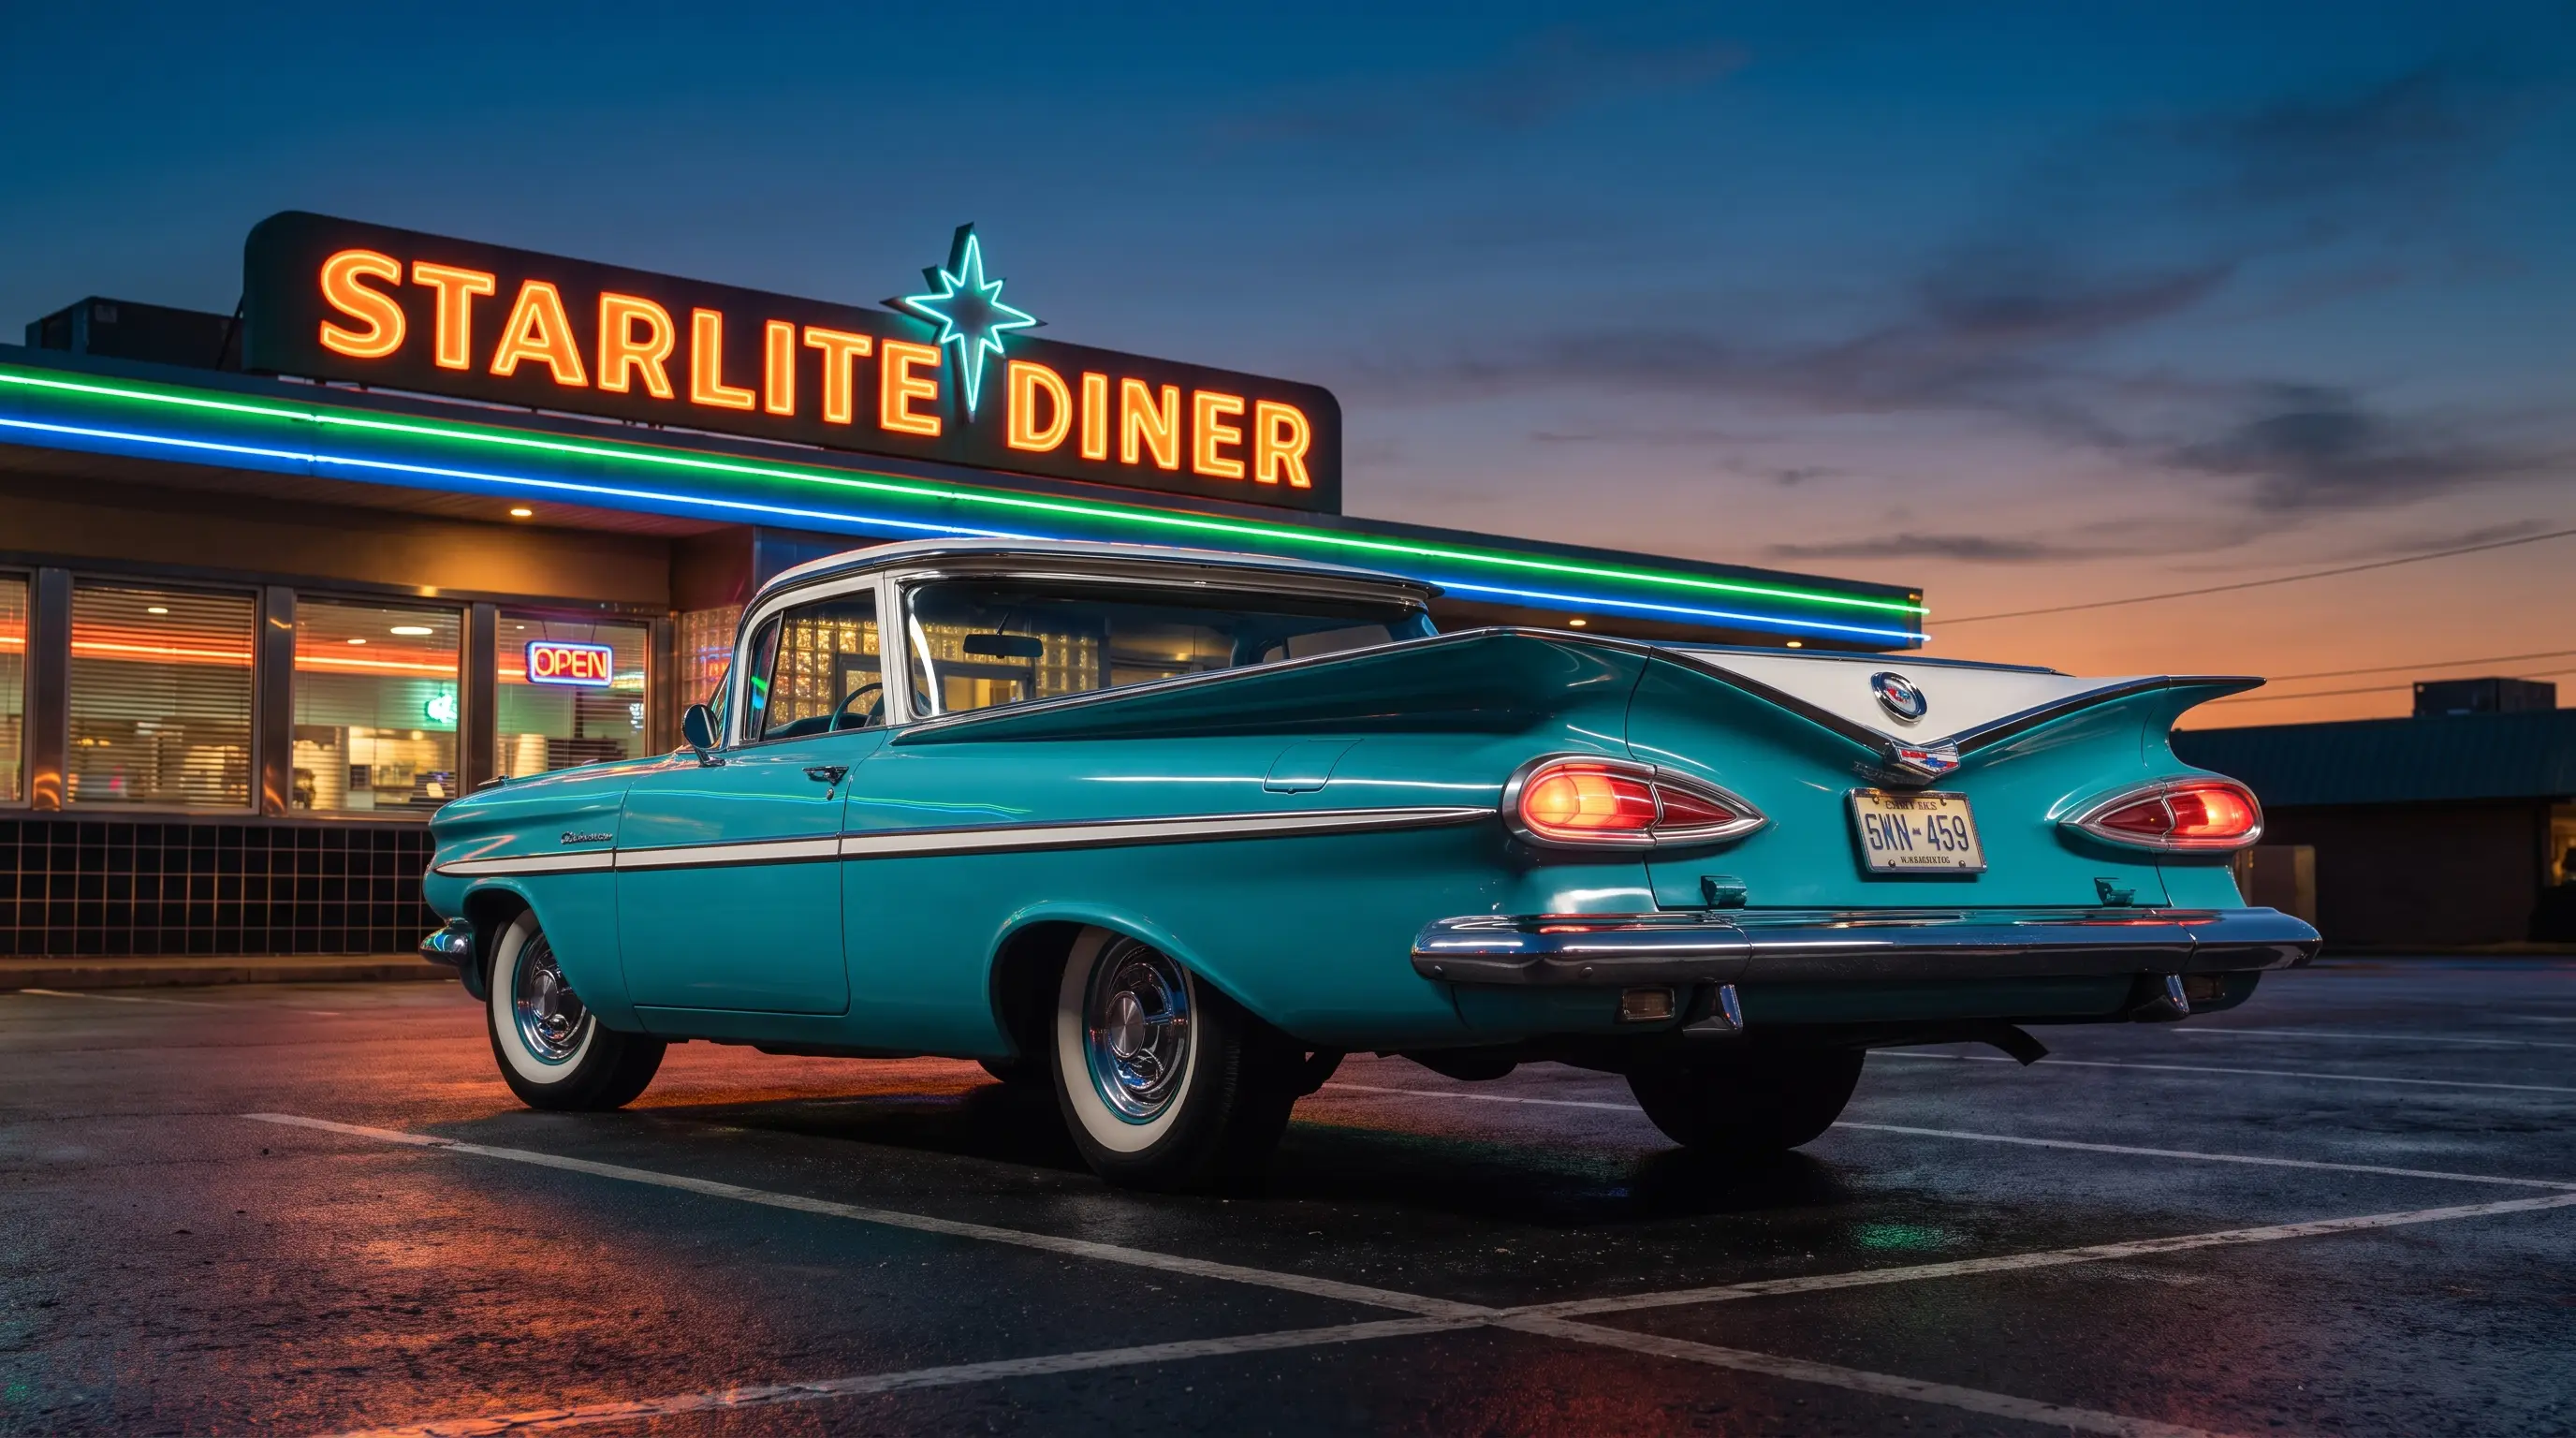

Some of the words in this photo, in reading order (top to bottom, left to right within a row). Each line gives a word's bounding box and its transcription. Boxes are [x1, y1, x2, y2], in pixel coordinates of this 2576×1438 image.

[318, 247, 943, 437] STARLITE
[1006, 358, 1312, 490] DINER
[534, 647, 607, 679] OPEN
